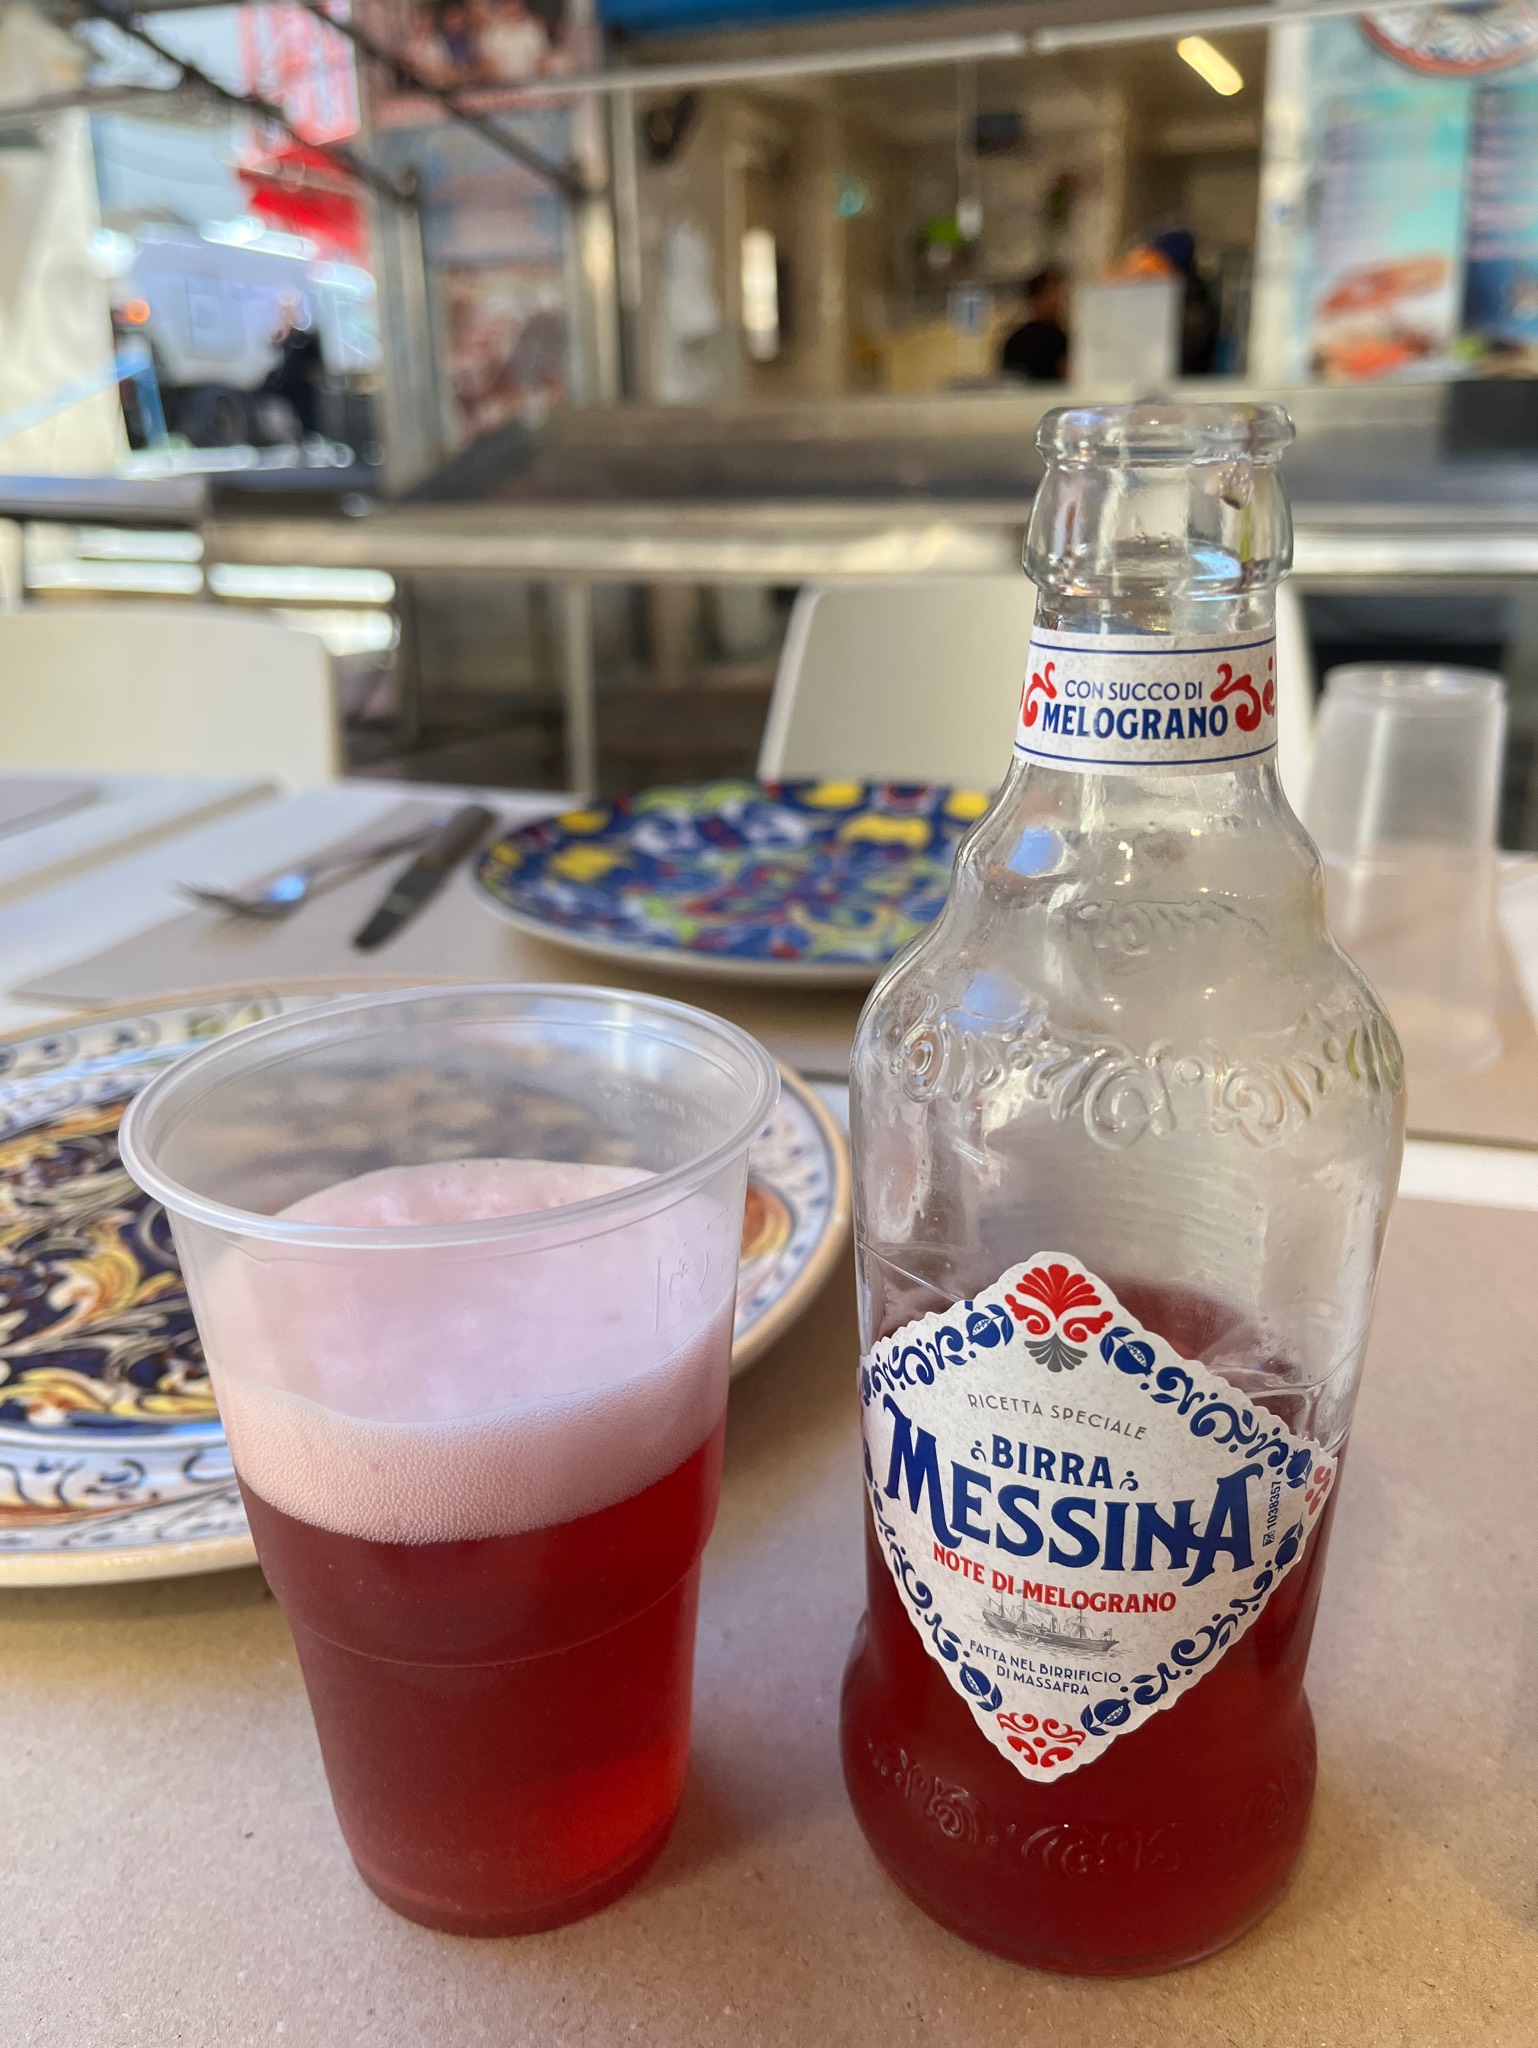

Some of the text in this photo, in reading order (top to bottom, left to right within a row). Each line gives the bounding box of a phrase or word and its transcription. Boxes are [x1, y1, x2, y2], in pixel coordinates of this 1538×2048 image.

[1064, 679, 1202, 701] CON SUCCO DI
[1042, 701, 1228, 740] MELOGRANO
[967, 1393, 1148, 1440] RICETTA SPECIALE
[991, 1433, 1114, 1490] BIRRA
[883, 1393, 1264, 1587] MESSINA
[1266, 1481, 1282, 1530] 1038357
[933, 1541, 1177, 1614] NOTE DI MELOGRANO
[969, 1639, 1122, 1684] FATTA NEL BIRRIFICIO
[996, 1665, 1090, 1696] DI MASSAFRA
